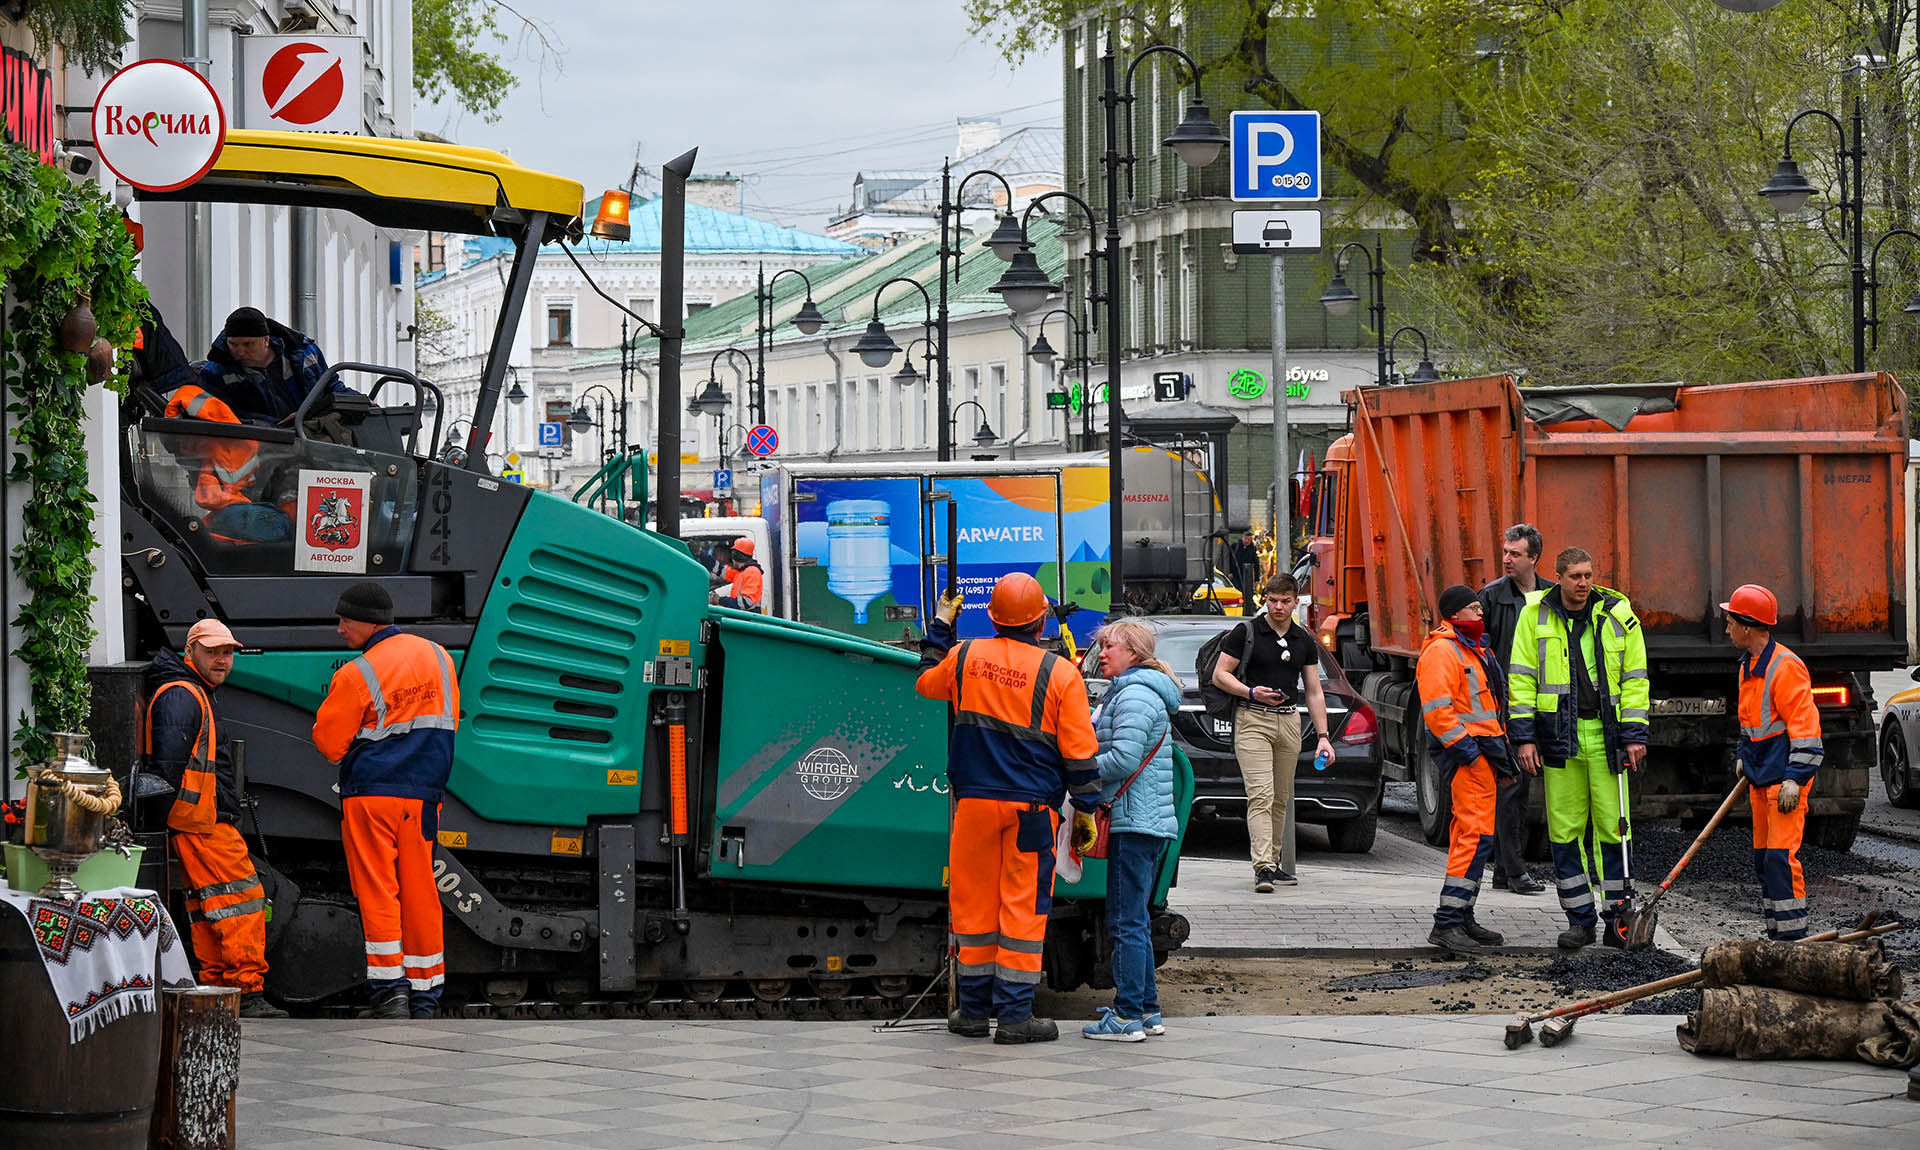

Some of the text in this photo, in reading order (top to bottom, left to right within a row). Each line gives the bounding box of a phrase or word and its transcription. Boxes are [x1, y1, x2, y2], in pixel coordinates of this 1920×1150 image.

[0, 42, 54, 166] чма
[104, 105, 211, 148] Корчма
[1247, 122, 1294, 190] P
[1274, 175, 1310, 186] 10 15 20
[1286, 366, 1329, 384] збука
[1286, 382, 1310, 401] aily
[316, 476, 355, 486] МОСКВА
[1838, 474, 1872, 483] NEFAZ
[1123, 494, 1170, 503] MASSENZA
[430, 467, 453, 566] 4044
[956, 526, 1045, 543] ARWATER
[310, 553, 354, 563] АВТОДОР
[956, 576, 993, 584] Доставка
[965, 586, 985, 595] (495)
[983, 661, 1027, 680] МОСКВА
[982, 670, 1026, 689] АВТОДОР
[798, 761, 858, 775] WIRTGEN
[800, 774, 853, 784] GROUP
